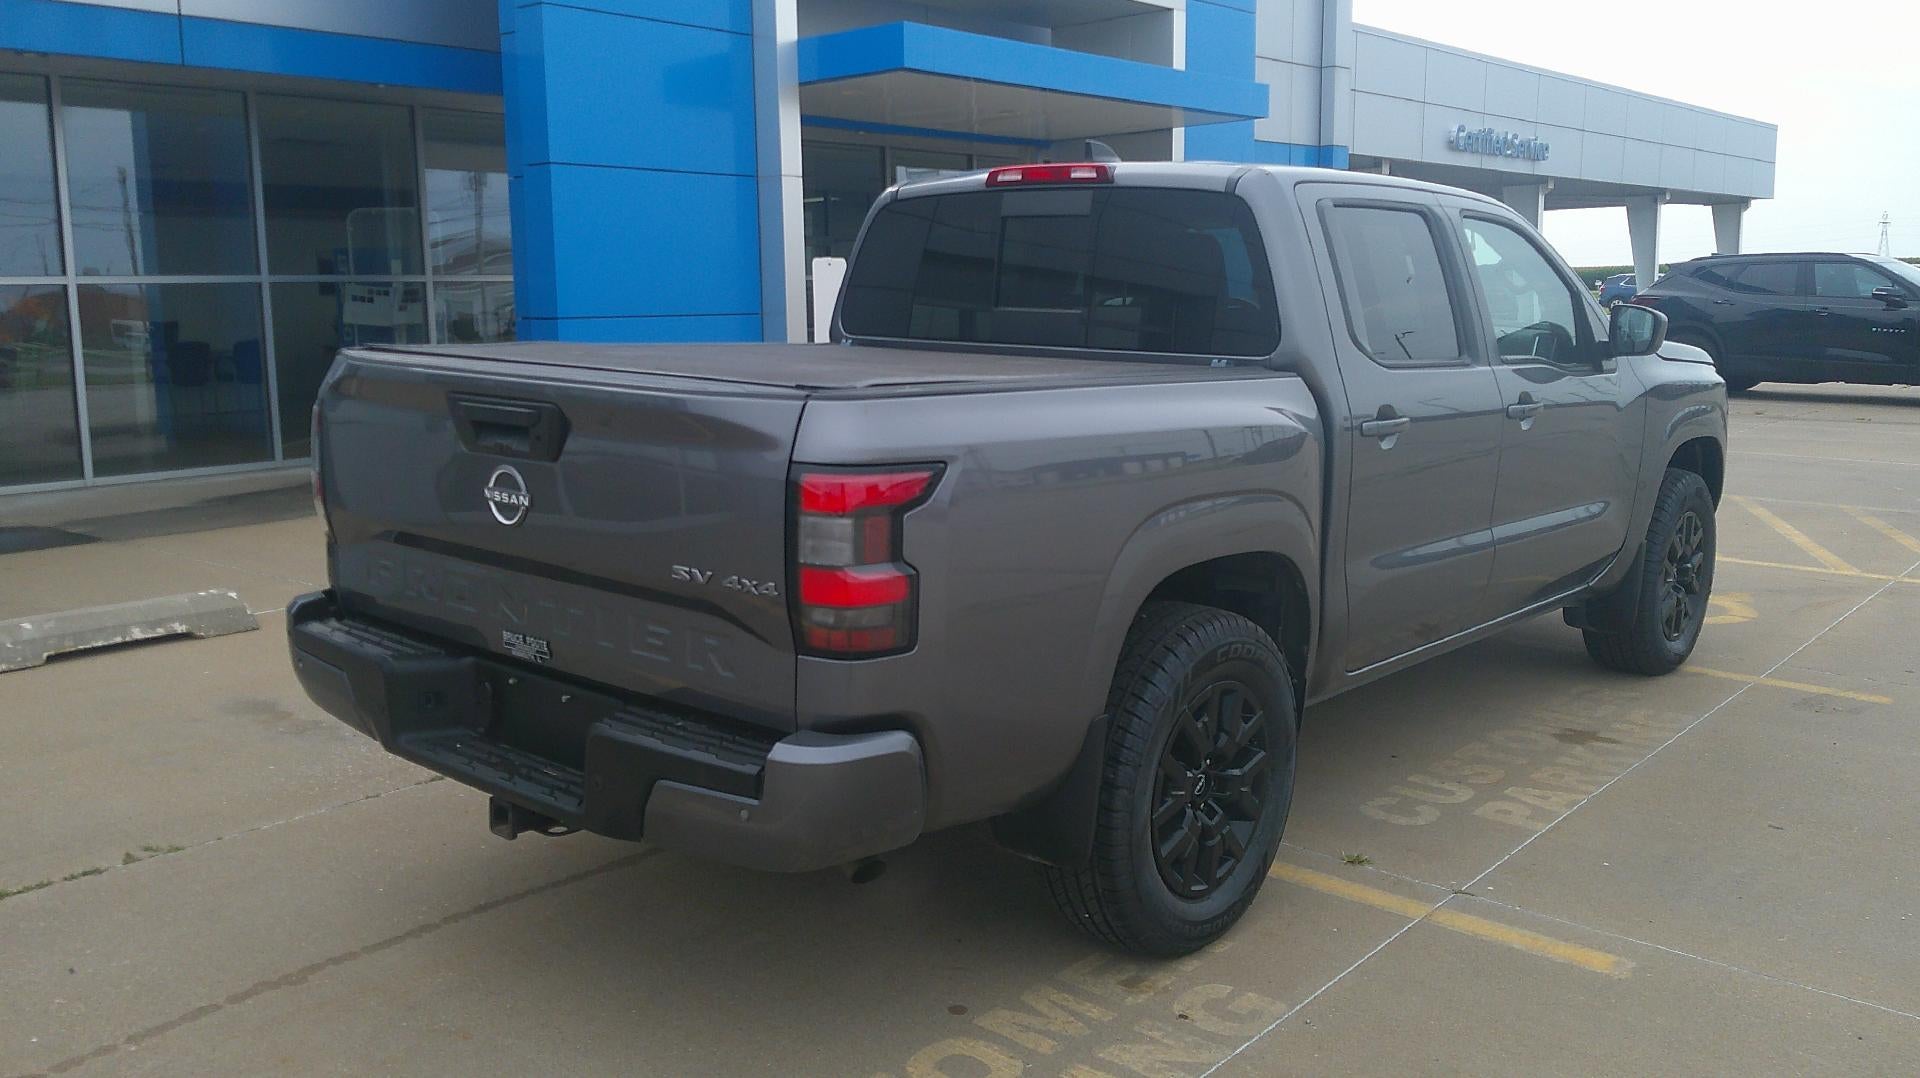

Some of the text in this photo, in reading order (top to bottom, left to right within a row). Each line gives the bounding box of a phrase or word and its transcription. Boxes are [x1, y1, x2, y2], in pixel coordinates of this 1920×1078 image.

[1455, 124, 1550, 161] Certified Service
[483, 488, 530, 507] NISSAN
[671, 564, 713, 585] SV
